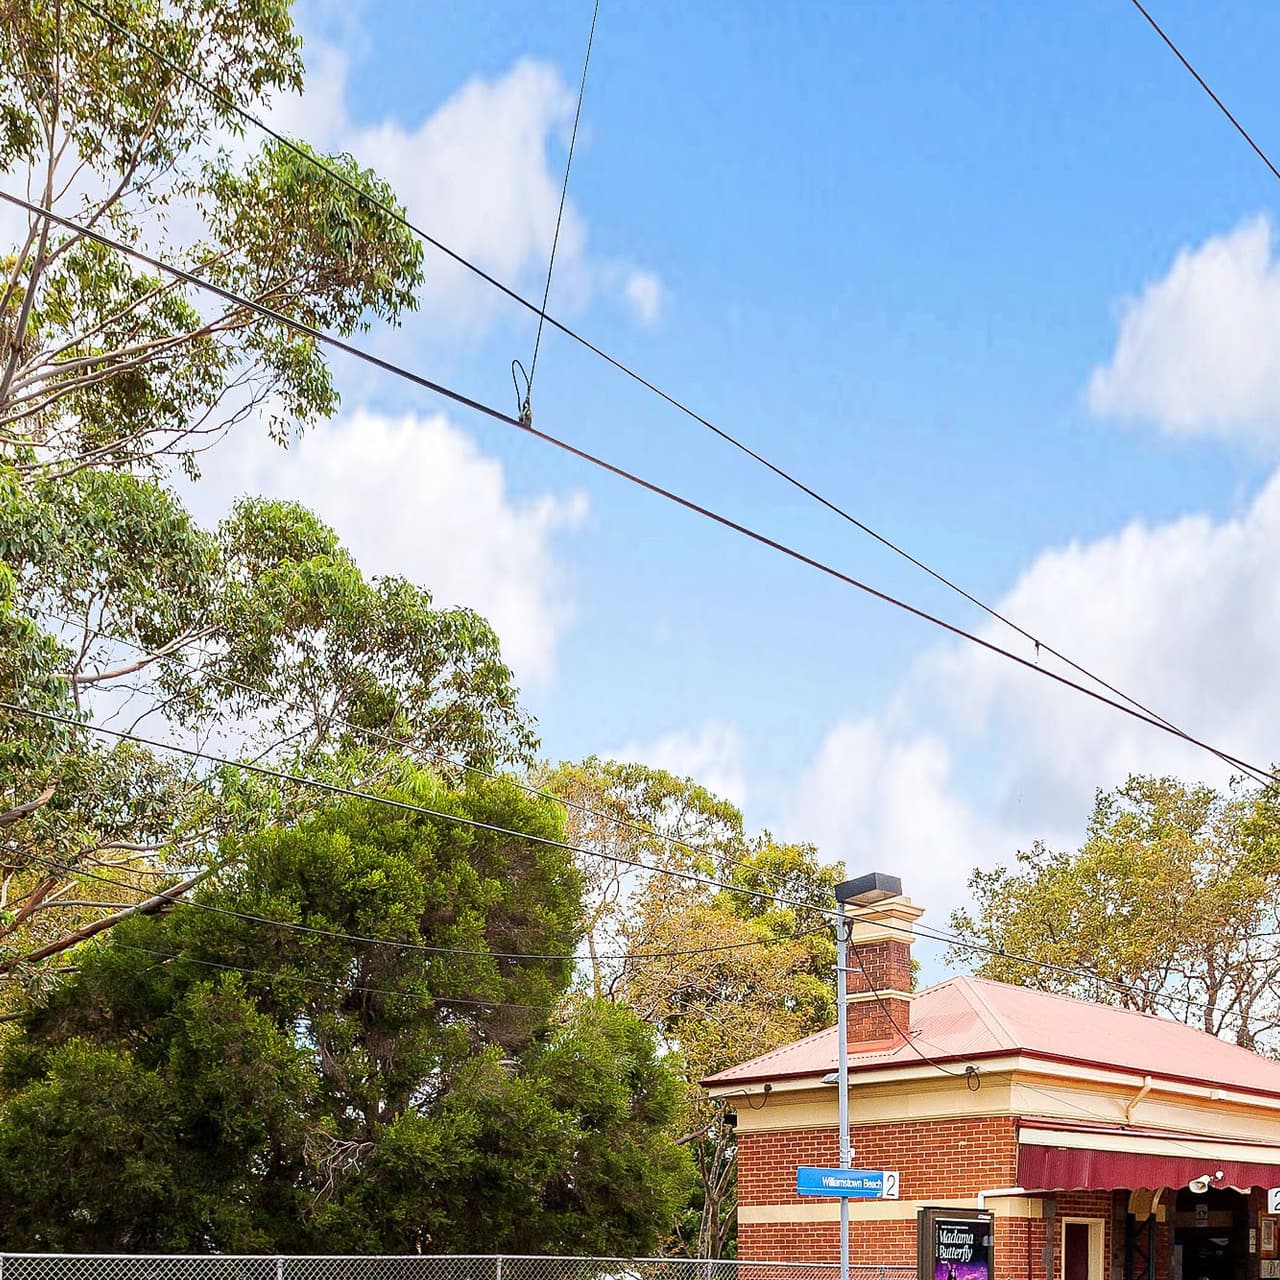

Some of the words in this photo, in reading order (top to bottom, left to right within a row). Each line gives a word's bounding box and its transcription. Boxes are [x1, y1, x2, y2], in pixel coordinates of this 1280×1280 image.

[822, 1176, 863, 1188] Williamstown
[863, 1178, 882, 1189] Beach
[886, 1174, 896, 1197] 2
[939, 1229, 974, 1244] Madama
[939, 1244, 973, 1262] Butterfly
